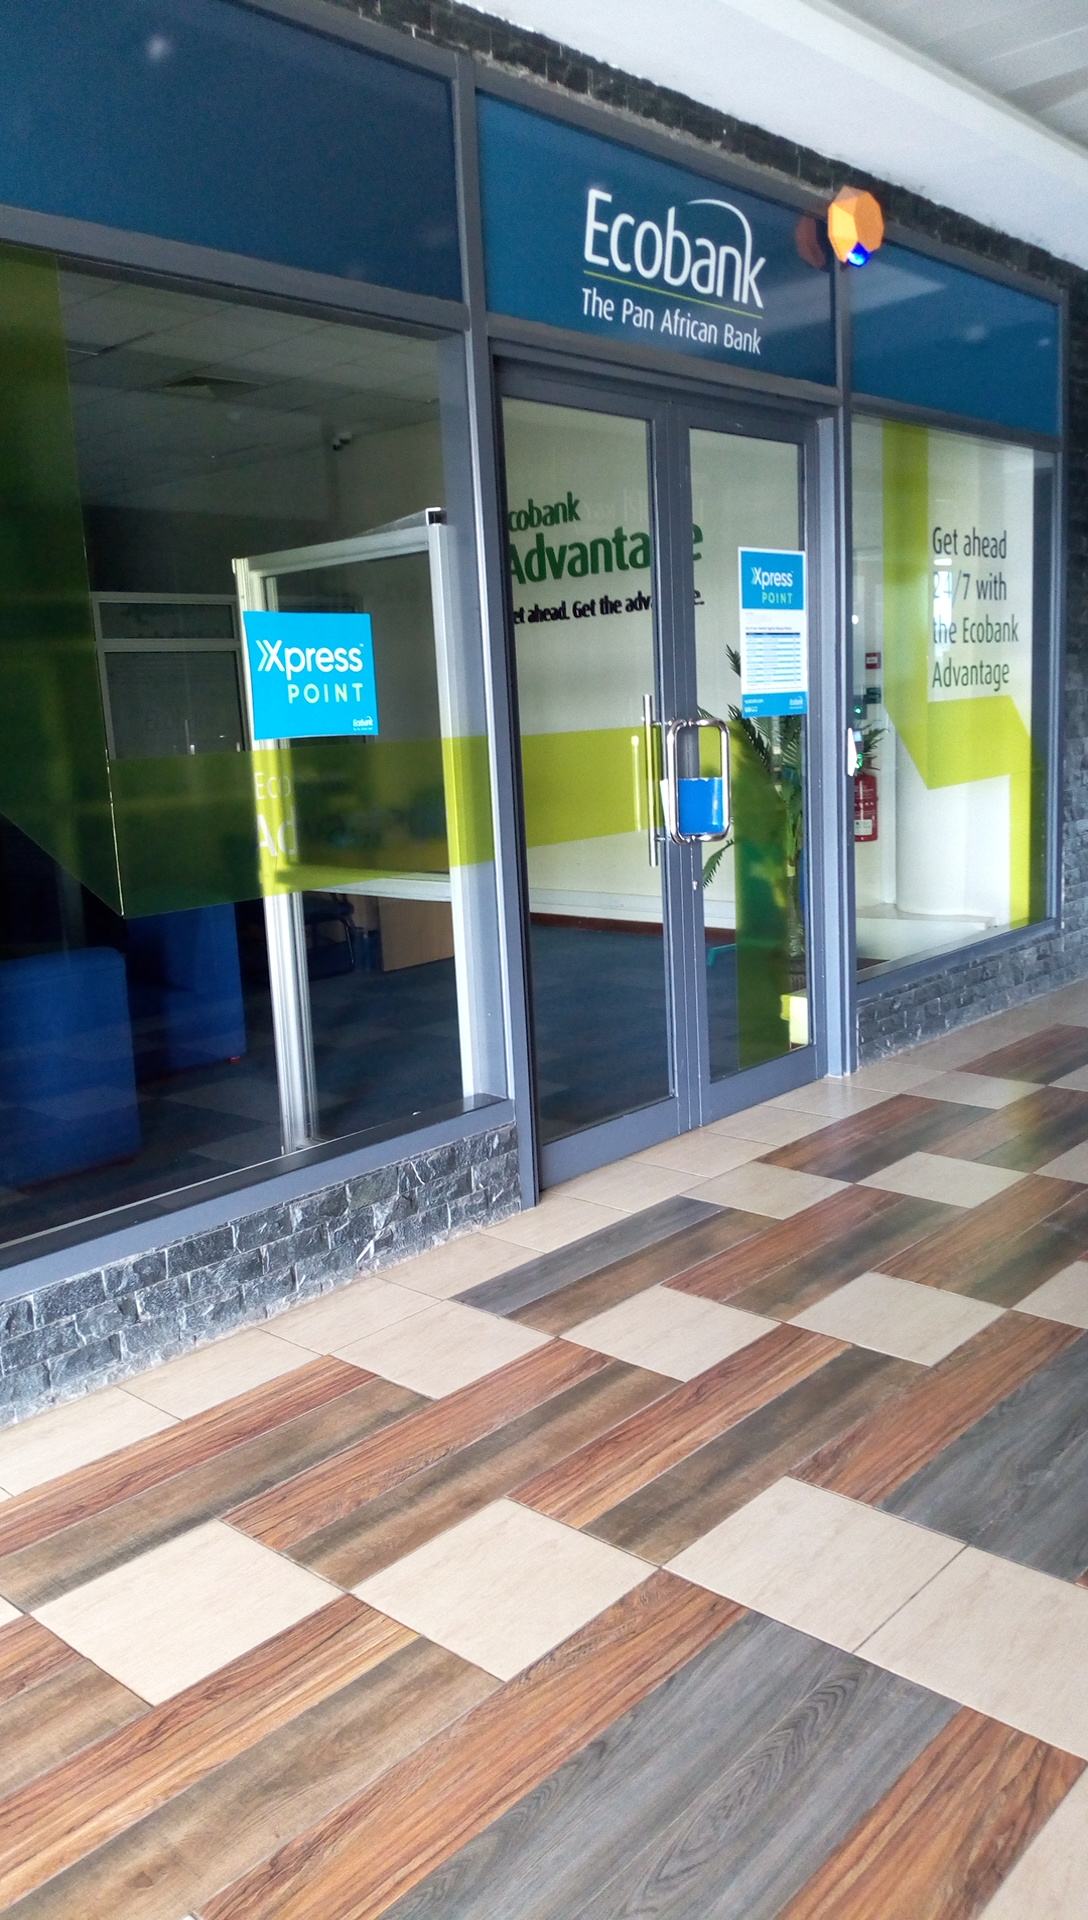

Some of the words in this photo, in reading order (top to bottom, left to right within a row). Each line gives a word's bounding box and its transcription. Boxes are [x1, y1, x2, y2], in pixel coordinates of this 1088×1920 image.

[584, 188, 766, 309] Ecobank
[582, 287, 614, 322] The
[622, 298, 654, 331] Pan
[661, 308, 718, 345] African
[723, 322, 762, 355] Bank
[507, 490, 581, 532] cobank
[509, 523, 704, 585] Advantae
[932, 526, 958, 556] Get
[963, 527, 1007, 559] ahead
[753, 567, 793, 591] Xpress
[933, 570, 971, 608] 24/7
[976, 572, 1007, 601] with
[513, 605, 525, 625] et
[572, 598, 596, 619] Get
[599, 594, 622, 614] the
[762, 592, 793, 604] POINT
[932, 616, 957, 644] the
[962, 614, 1019, 643] Ecobank
[259, 639, 363, 681] Xpress
[932, 657, 1010, 691] Advantage
[287, 683, 363, 704] POINT
